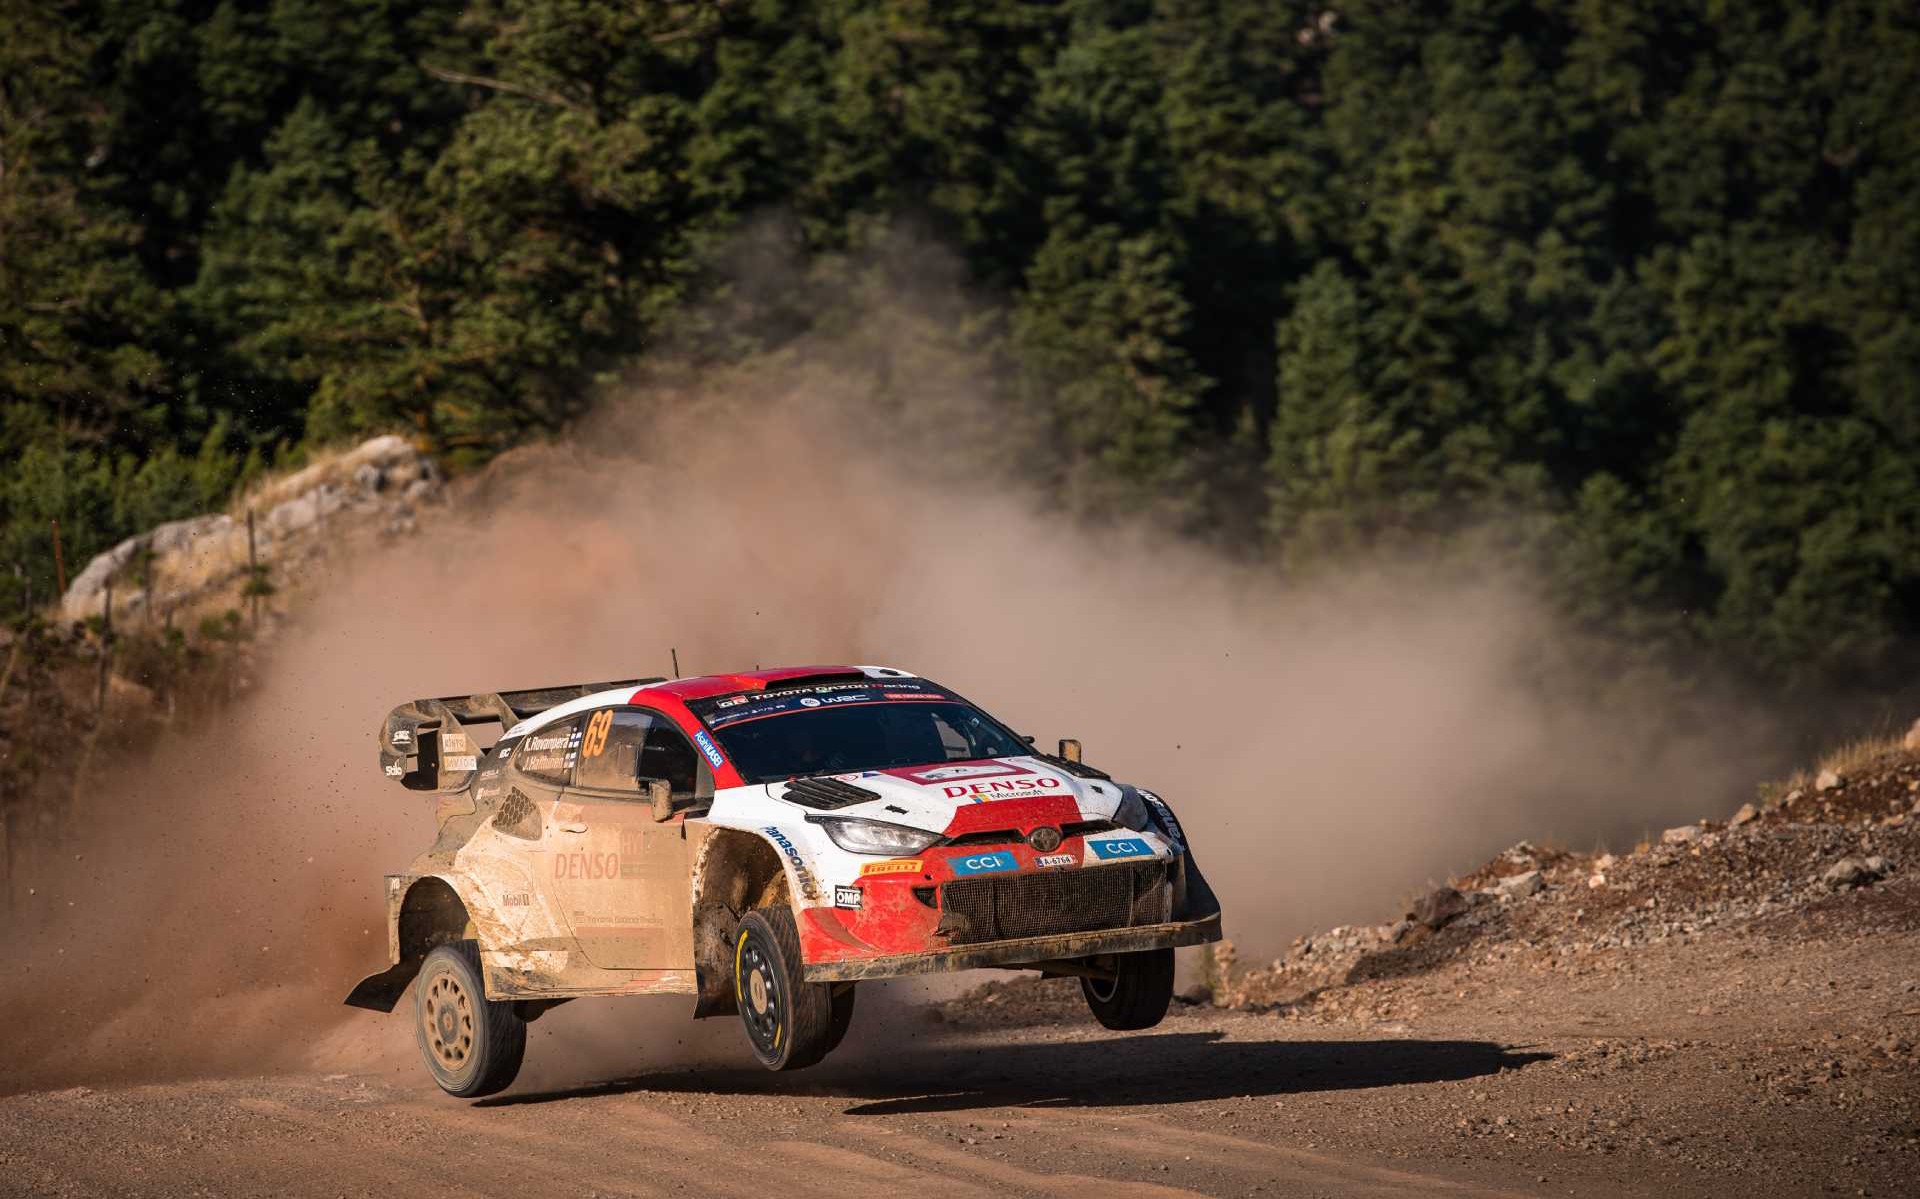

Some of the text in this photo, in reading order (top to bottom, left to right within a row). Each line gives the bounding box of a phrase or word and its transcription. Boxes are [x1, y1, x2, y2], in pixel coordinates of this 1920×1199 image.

[751, 688, 812, 701] TOYOTA
[815, 683, 869, 694] GAZOO
[821, 694, 870, 703] WRC
[582, 709, 614, 758] 69
[944, 777, 1060, 799] DENSO
[990, 789, 1045, 799] Microsoft
[1106, 841, 1137, 854] CCI
[555, 853, 619, 880] DENSO
[863, 862, 917, 873] PIRELLI
[966, 856, 1001, 870] CCI
[836, 891, 861, 903] OMP
